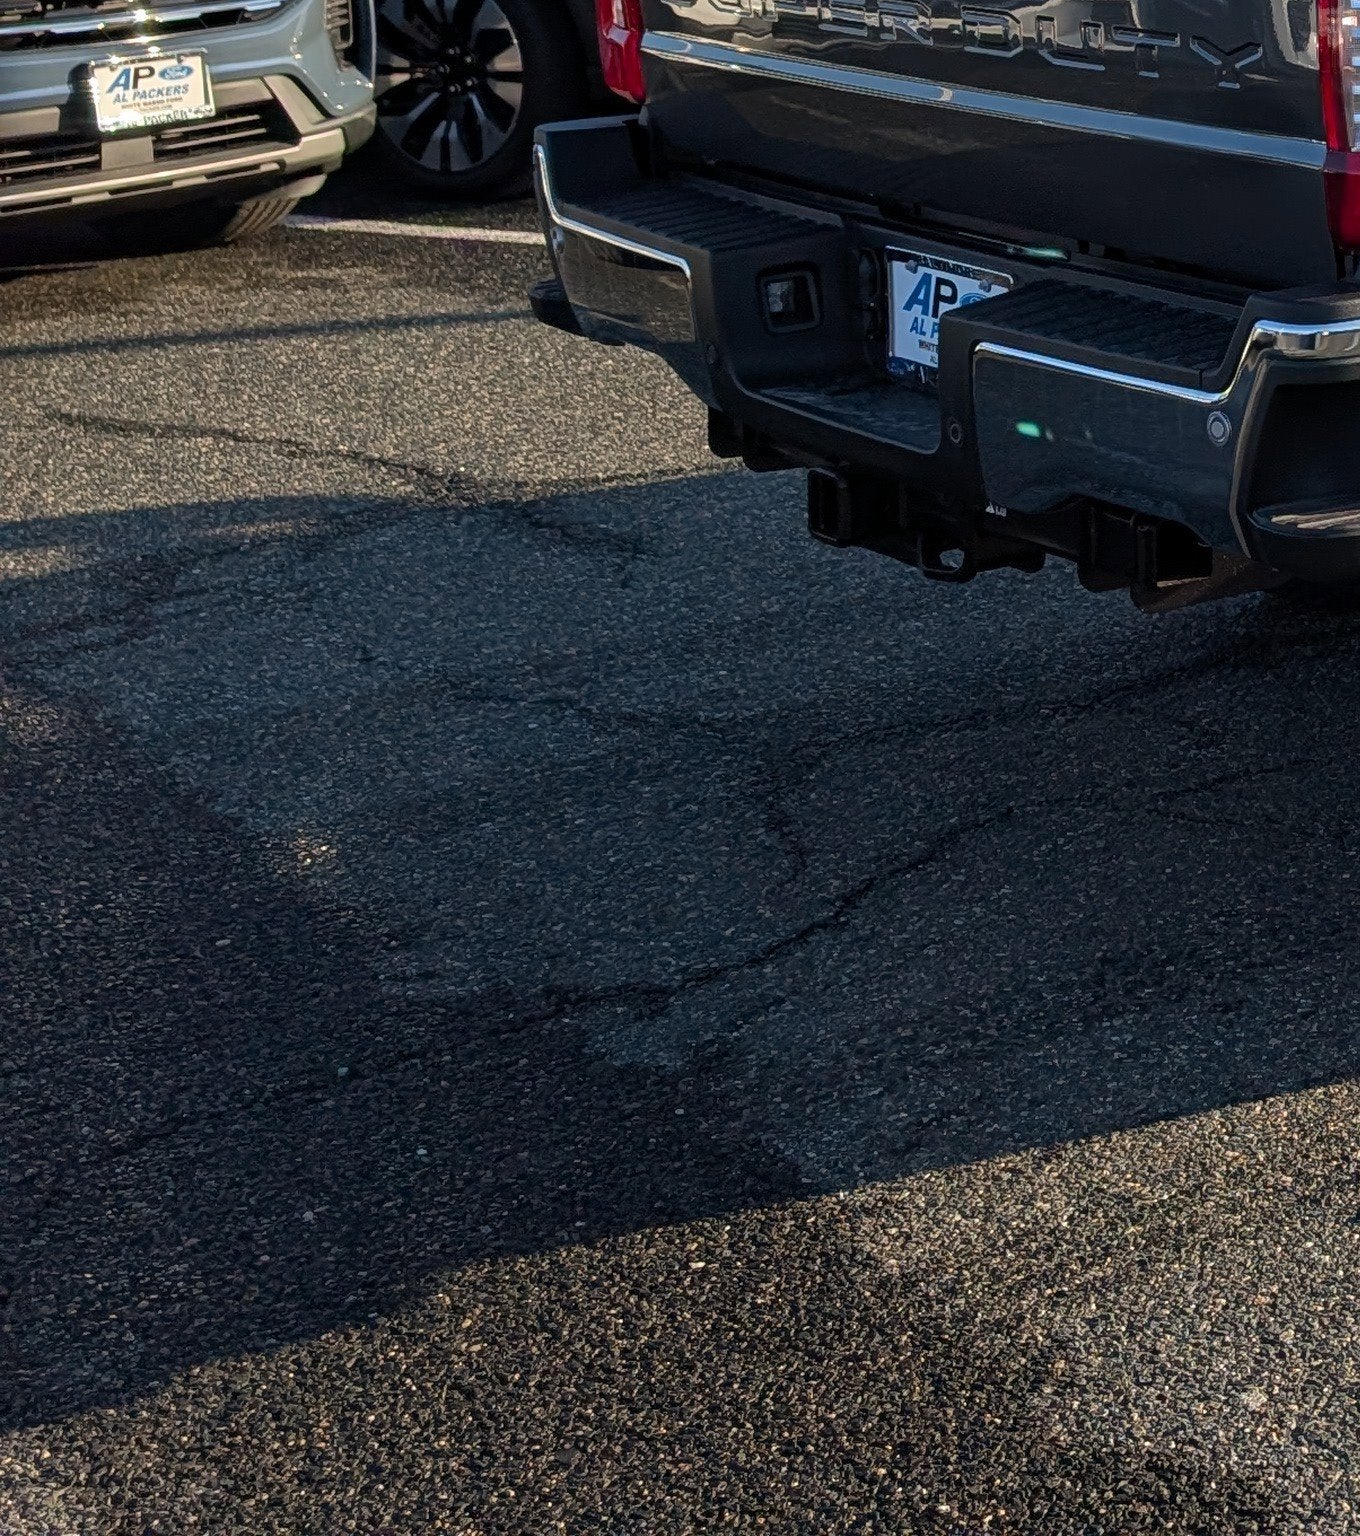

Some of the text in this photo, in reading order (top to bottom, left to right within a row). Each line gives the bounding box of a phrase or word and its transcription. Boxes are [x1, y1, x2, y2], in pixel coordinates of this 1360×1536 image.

[961, 4, 1263, 90] DUTY
[106, 66, 155, 93] AP
[112, 84, 189, 104] AL PACKERS
[903, 272, 958, 319] AP
[909, 316, 926, 336] AL
